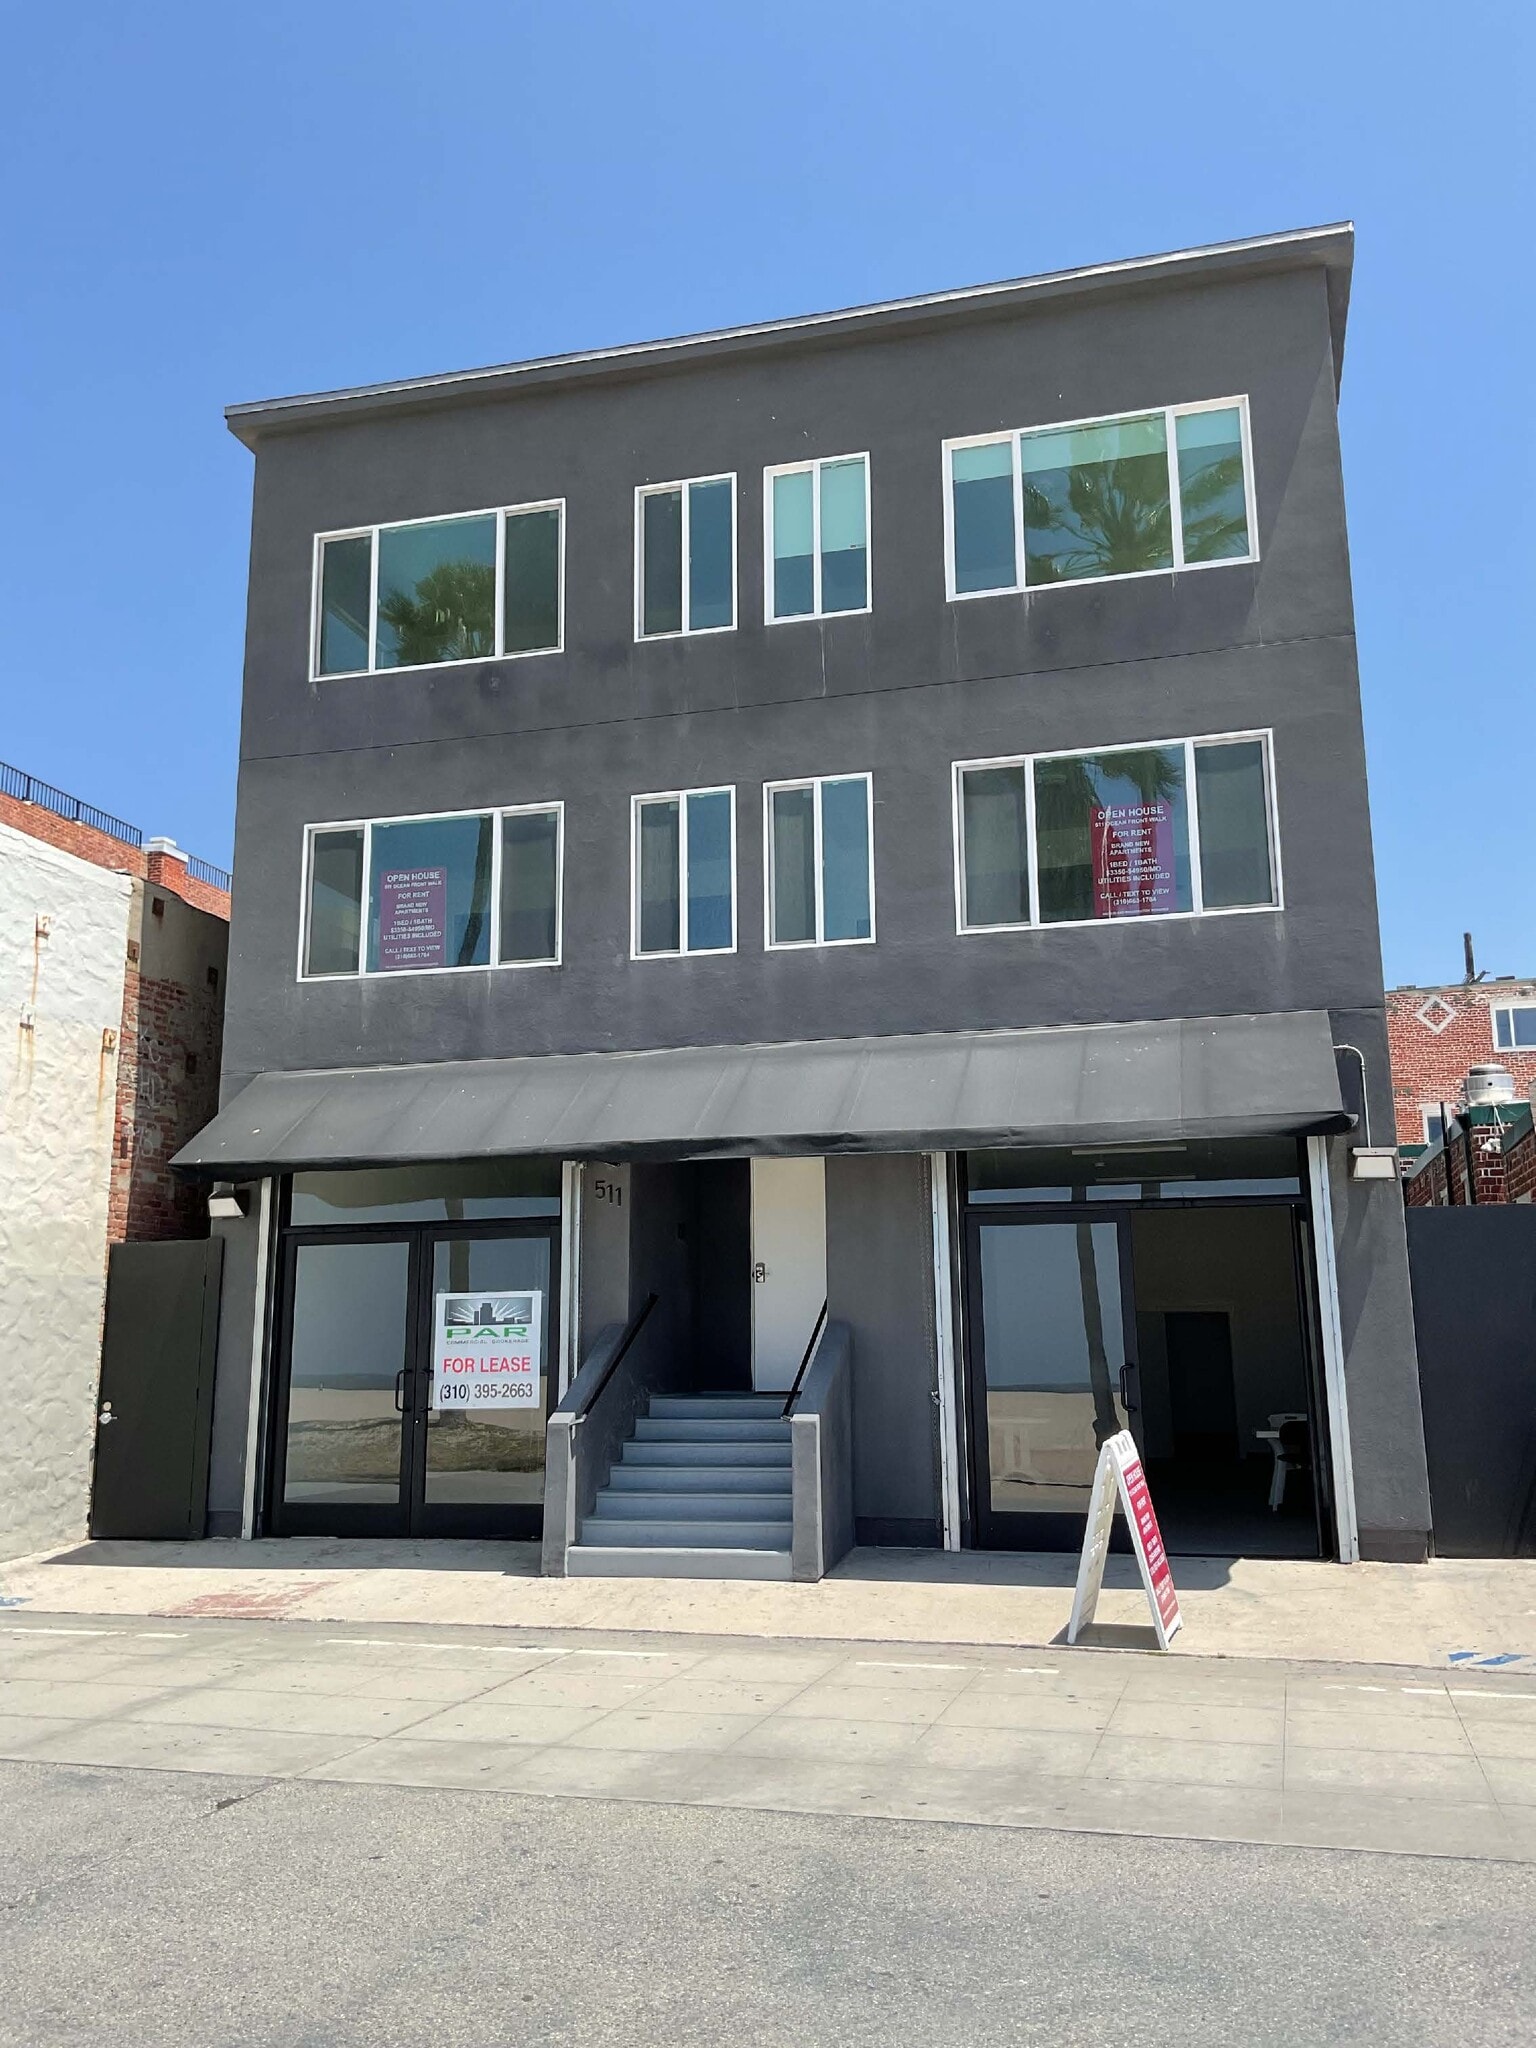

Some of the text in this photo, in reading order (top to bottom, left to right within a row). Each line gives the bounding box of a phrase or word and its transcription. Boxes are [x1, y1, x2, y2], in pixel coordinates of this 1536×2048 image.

[1097, 805, 1164, 820] OPEN HOUSE
[1112, 828, 1152, 838] FOR RENT
[1111, 841, 1134, 849] BRAND
[1109, 847, 1152, 856] APARTMENTS
[1109, 860, 1128, 868] 1BED
[387, 871, 441, 883] OPEN HOUSE
[1097, 872, 1170, 884] UTILITIES INCLUDED
[1123, 890, 1139, 898] TEXT
[412, 930, 442, 938] INCLUDED
[595, 1180, 622, 1206] 511
[446, 1326, 528, 1339] PAR
[443, 1356, 531, 1373] FOR LEASE
[440, 1383, 533, 1403] (310) 395-2663
